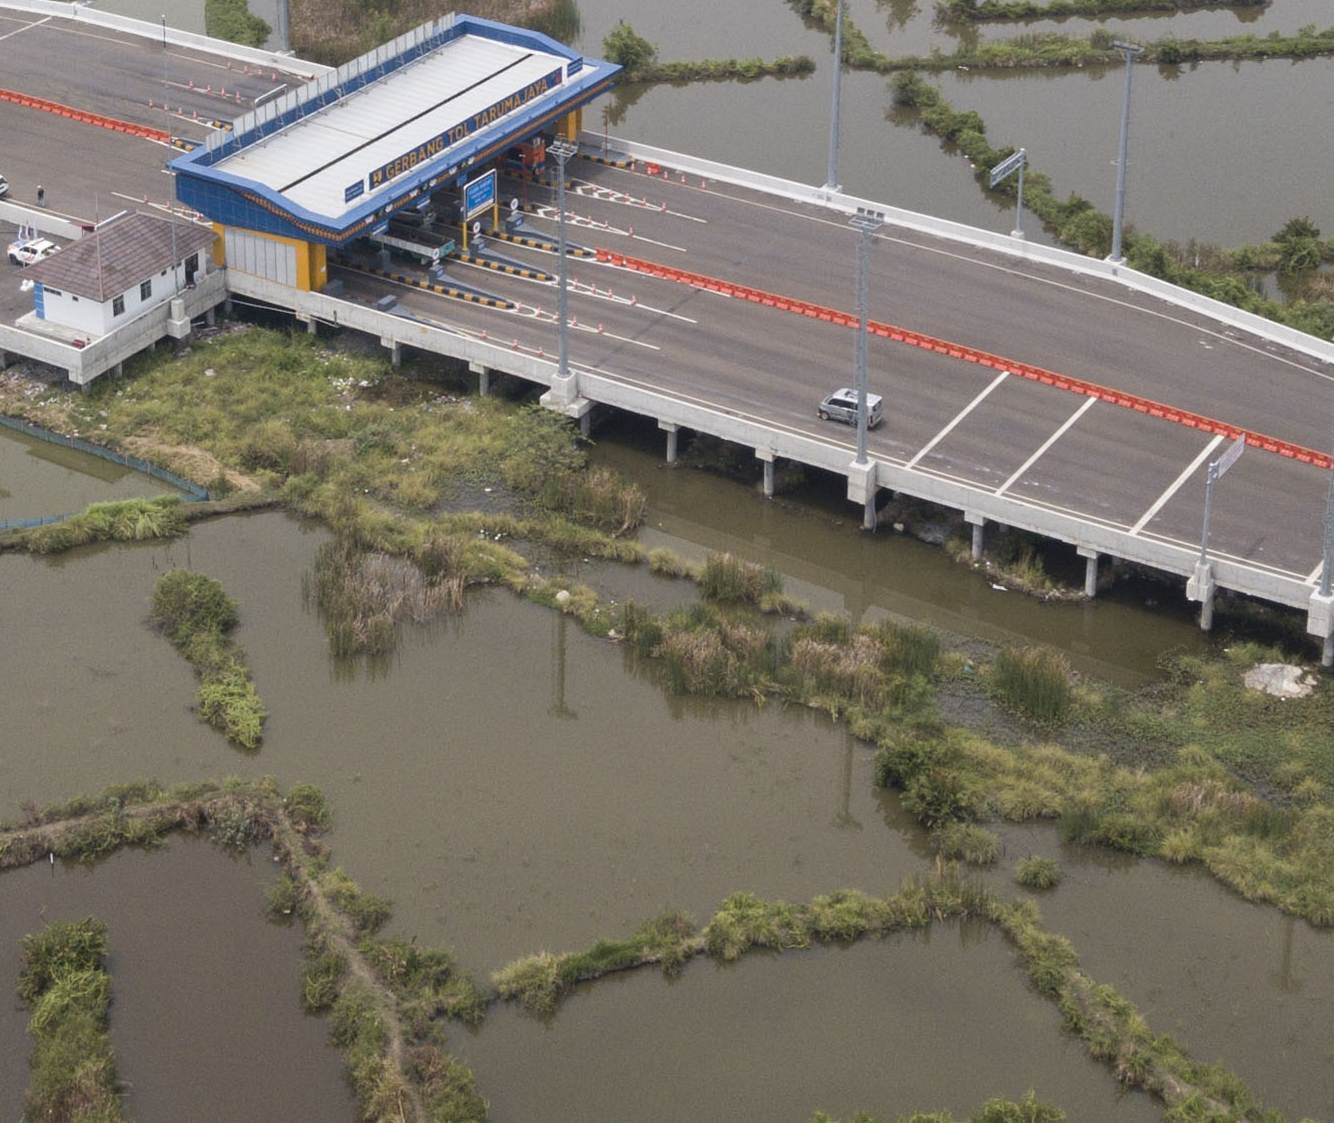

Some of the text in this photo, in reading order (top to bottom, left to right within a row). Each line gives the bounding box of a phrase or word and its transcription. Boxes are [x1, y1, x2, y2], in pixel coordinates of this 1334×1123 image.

[386, 78, 548, 179] GERBANG TOL TARUMAJAYA
